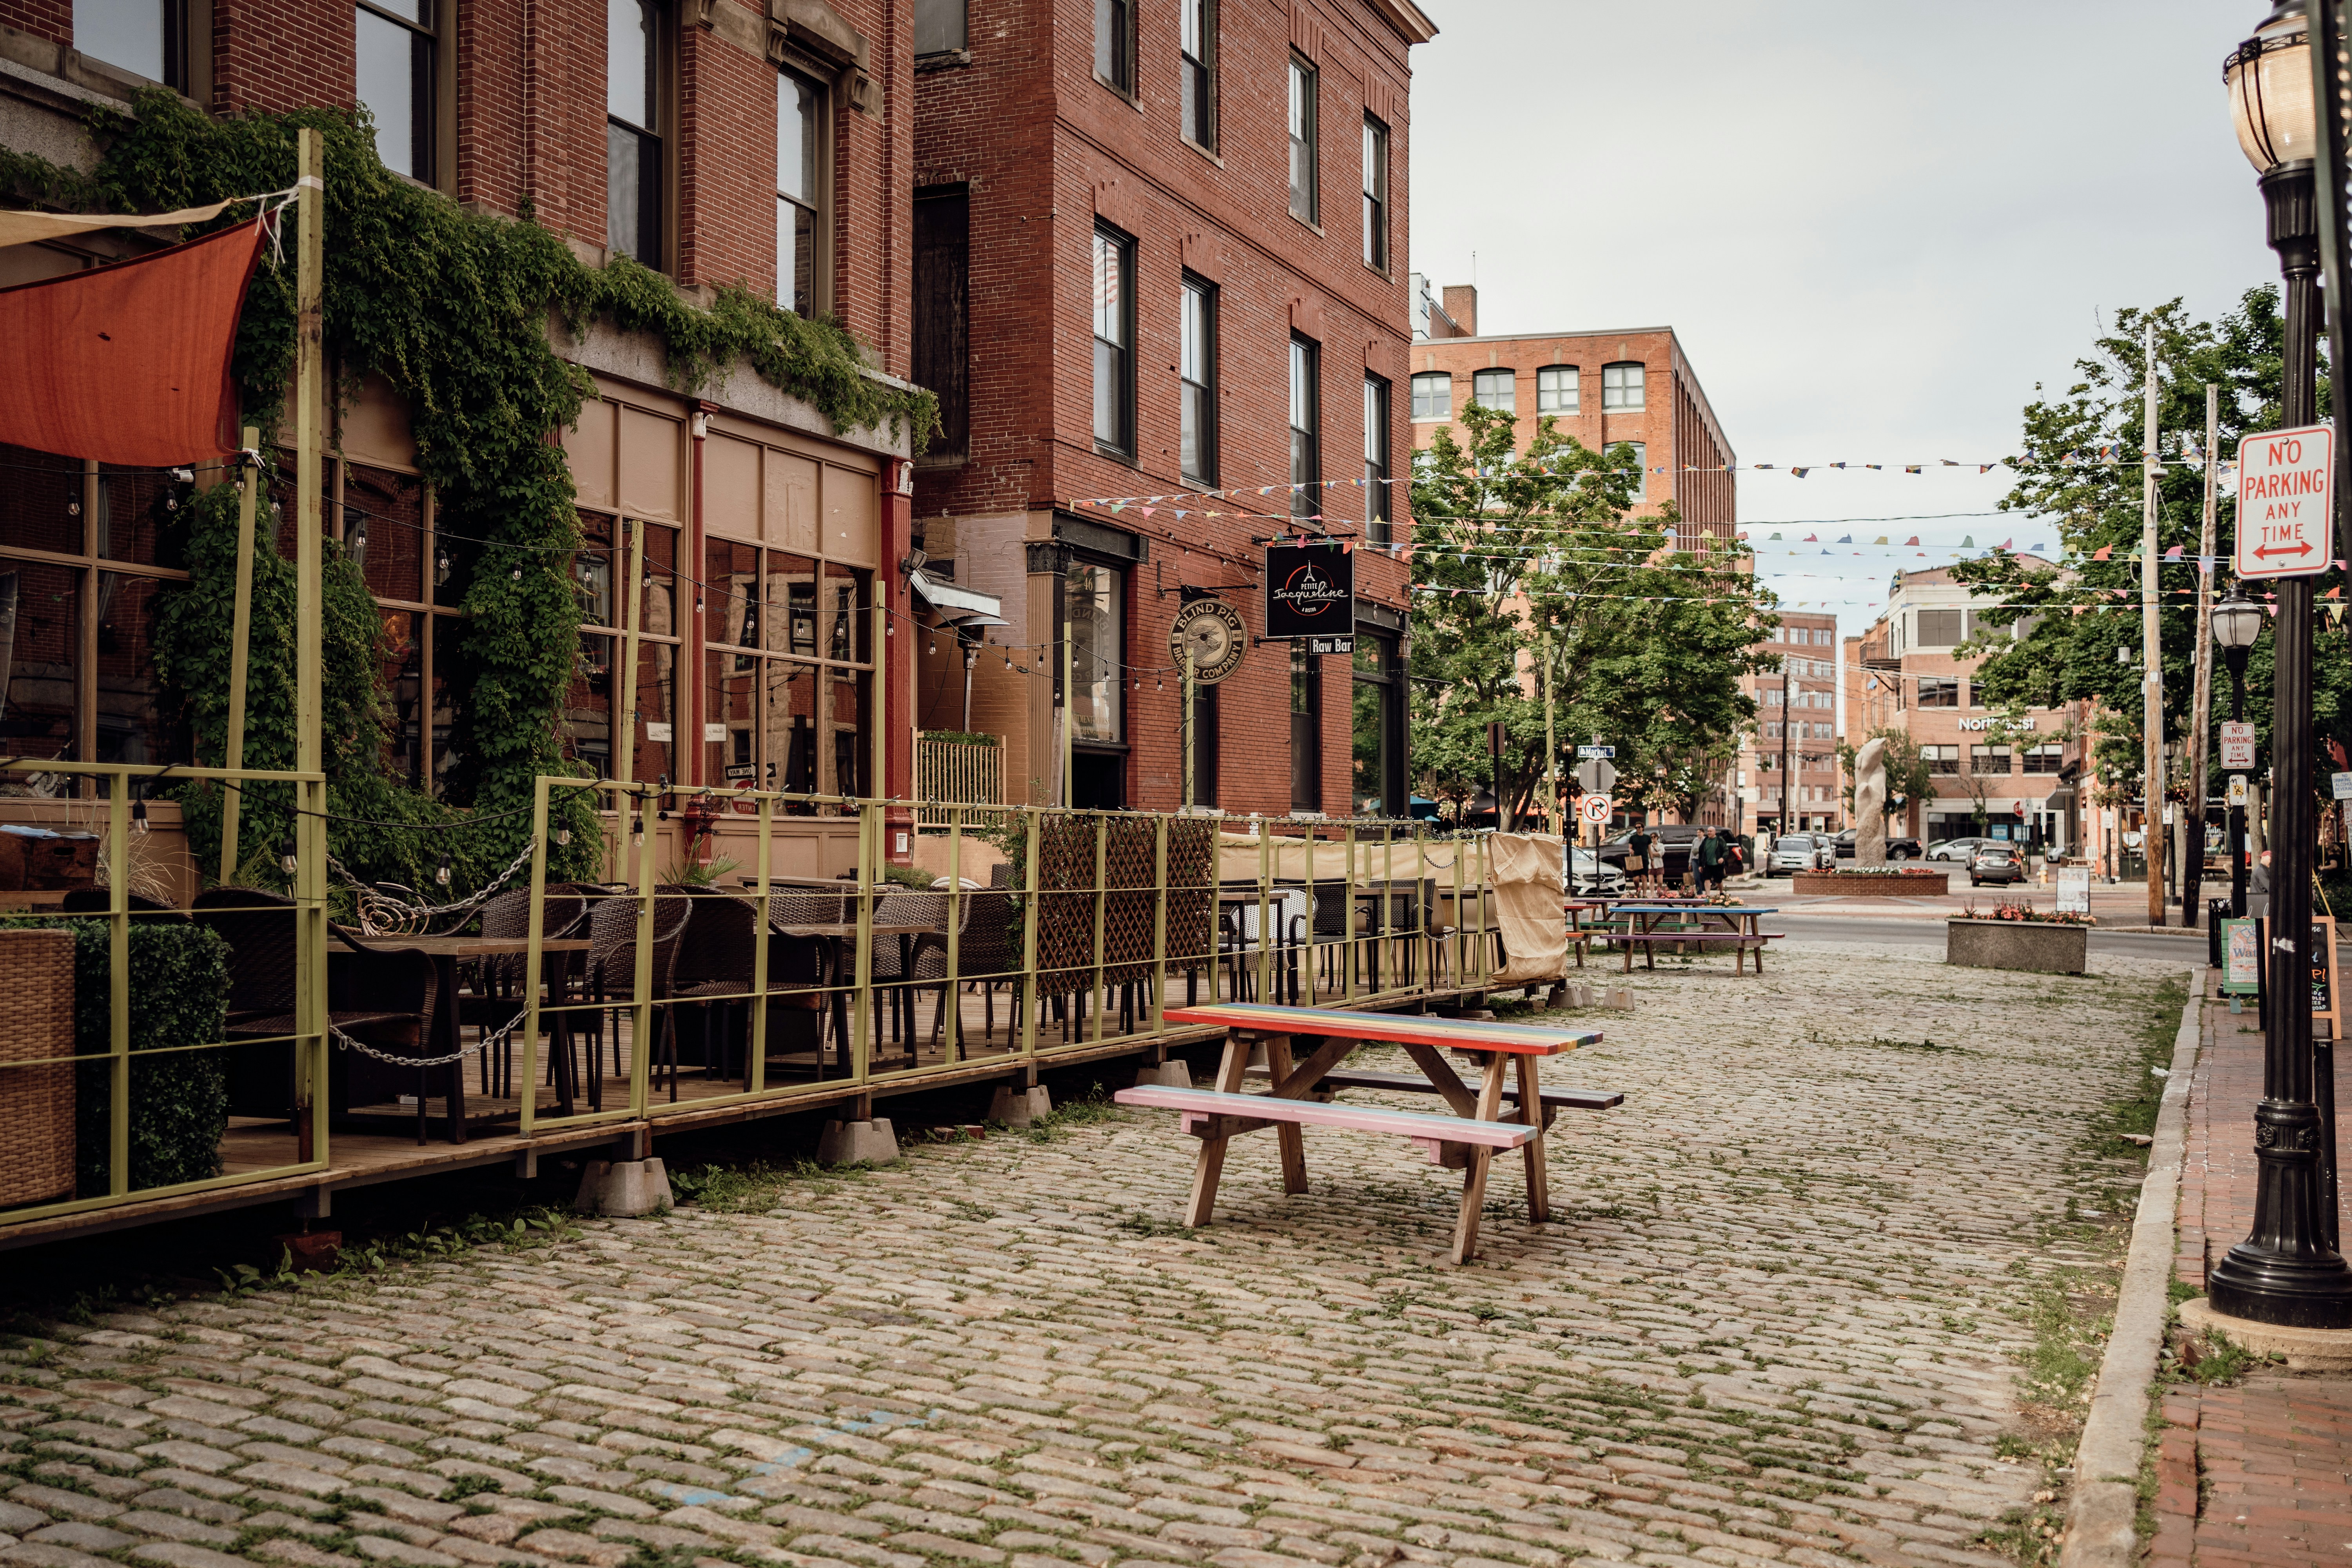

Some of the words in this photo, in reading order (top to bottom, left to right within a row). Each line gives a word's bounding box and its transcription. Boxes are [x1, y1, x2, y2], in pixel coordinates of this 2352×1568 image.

[2268, 440, 2301, 466] NO
[2245, 468, 2324, 500] PARKING
[2265, 501, 2301, 520] ANY
[2261, 523, 2304, 543] TIME
[1083, 577, 1093, 591] 46
[1273, 581, 1348, 605] Jacqueline
[1177, 604, 1214, 629] BLIND
[1217, 606, 1238, 628] PIG
[1313, 639, 1332, 653] Raw
[1335, 638, 1352, 652] Bar
[1173, 646, 1200, 678] BARR
[1203, 644, 1241, 679] COMPANY
[1586, 747, 1607, 756] Market
